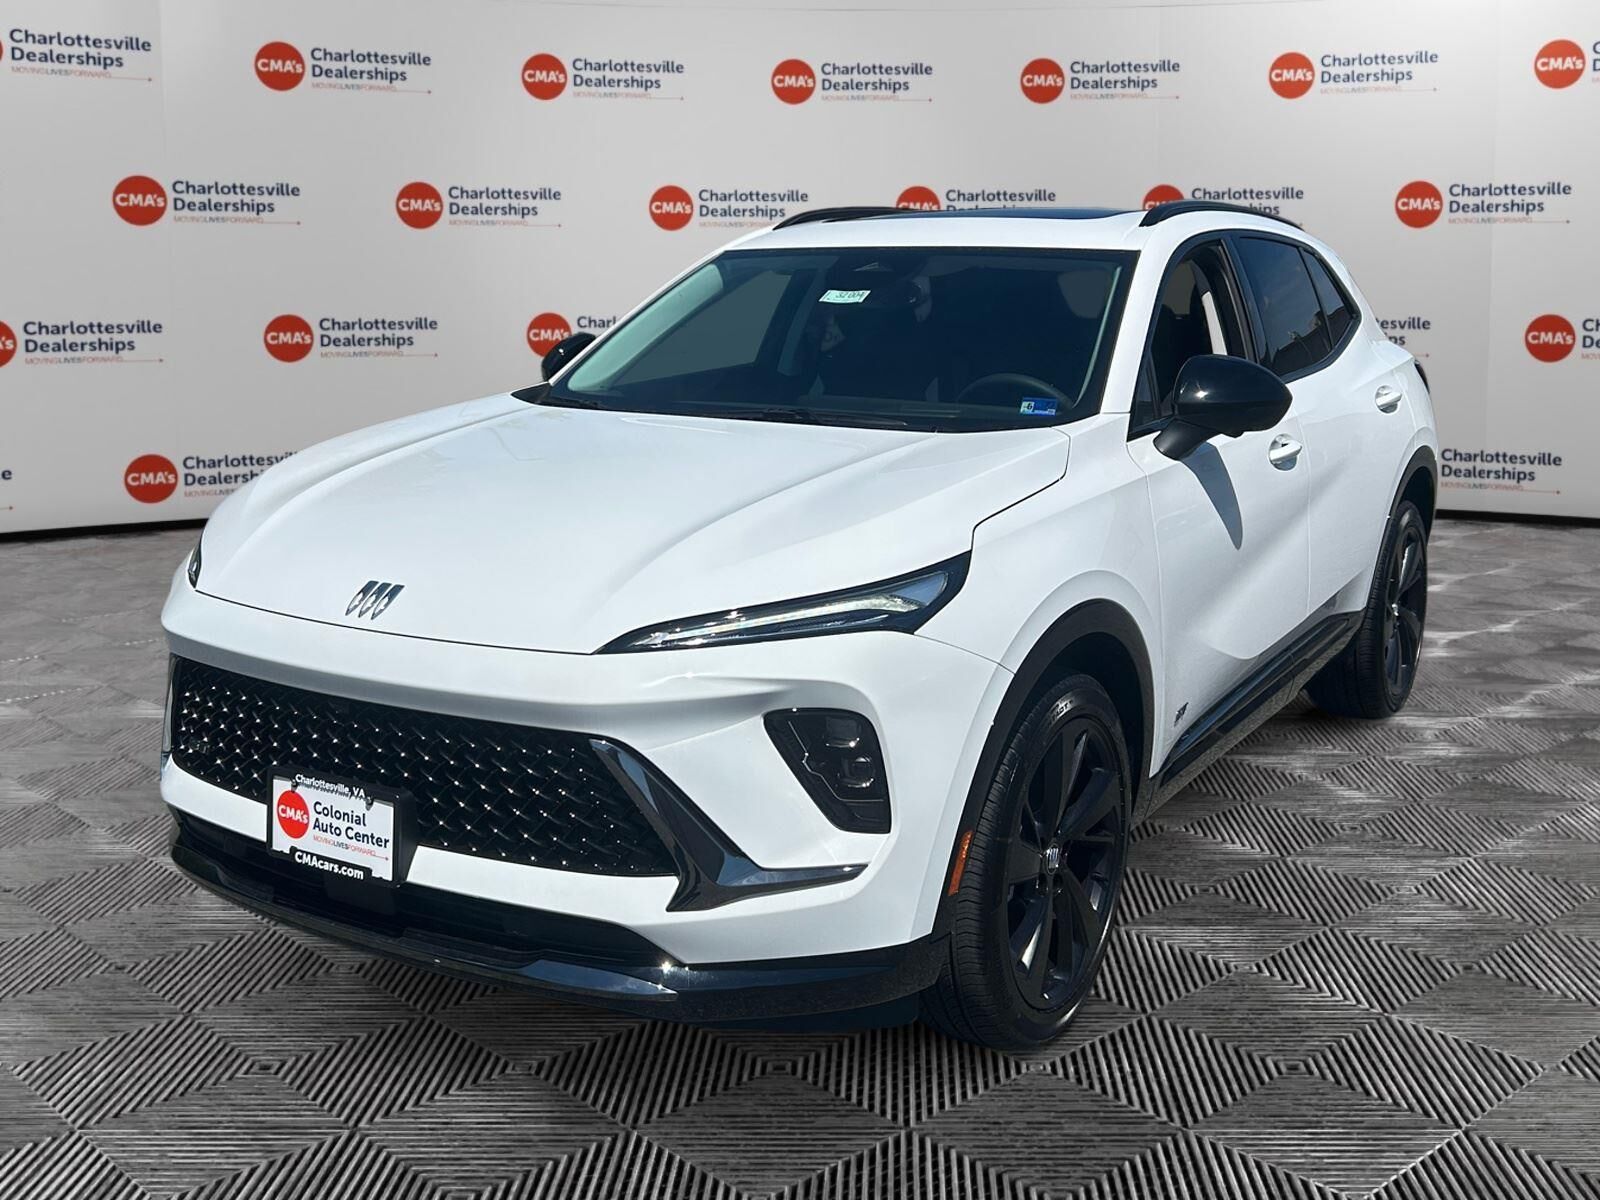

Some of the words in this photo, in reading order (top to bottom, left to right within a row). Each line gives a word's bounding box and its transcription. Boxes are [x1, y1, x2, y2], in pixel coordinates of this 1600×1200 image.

[9, 28, 152, 53] Charlottesville
[10, 46, 124, 69] Dealerships
[310, 47, 432, 67] Charlottesville
[1320, 50, 1438, 68] Charlottesville
[1536, 55, 1584, 71] CMA's
[256, 58, 304, 74] CMA's
[311, 64, 408, 83] Dealerships
[572, 58, 684, 74] Charlottesville
[821, 62, 933, 76] Charlottesville
[1070, 59, 1180, 74] Charlottesville
[524, 69, 566, 84] CMA's
[573, 74, 661, 91] Dealerships
[773, 75, 814, 88] CMA's
[1022, 74, 1063, 88] CMA's
[1070, 75, 1158, 92] Dealerships
[1271, 68, 1313, 83] CMA's
[1320, 67, 1413, 84] Dealerships
[822, 78, 910, 93] Dealerships
[172, 179, 300, 198] Charlottesville
[448, 186, 561, 201] Charlottesville
[698, 189, 808, 202] Charlottesville
[946, 189, 1056, 202] Charlottesville
[1191, 187, 1304, 200] Charlottesville
[1448, 181, 1572, 198] Charlottesville
[115, 193, 165, 208] CMA's
[173, 197, 275, 216] Dealerships
[399, 197, 441, 212] CMA's
[651, 201, 692, 215] CMA's
[1397, 197, 1442, 212] CMA's
[1448, 198, 1545, 214] Dealerships
[448, 202, 538, 219] Dealerships
[699, 205, 785, 220] Dealerships
[23, 320, 163, 336] Charlottesville
[319, 317, 438, 332] Charlottesville
[25, 338, 136, 354] Dealerships
[267, 331, 312, 345] CMA's
[320, 332, 414, 348] Dealerships
[1527, 331, 1574, 345] CMA's
[1441, 448, 1562, 466] Charlottesville
[127, 471, 177, 486] CMA's
[1441, 465, 1535, 483] Dealerships
[353, 787, 366, 798] VA
[278, 805, 309, 824] CMA's
[313, 801, 367, 827] Colonial
[313, 818, 342, 837] Auto
[345, 827, 389, 849] Center
[295, 853, 364, 880] CMAcars.com
